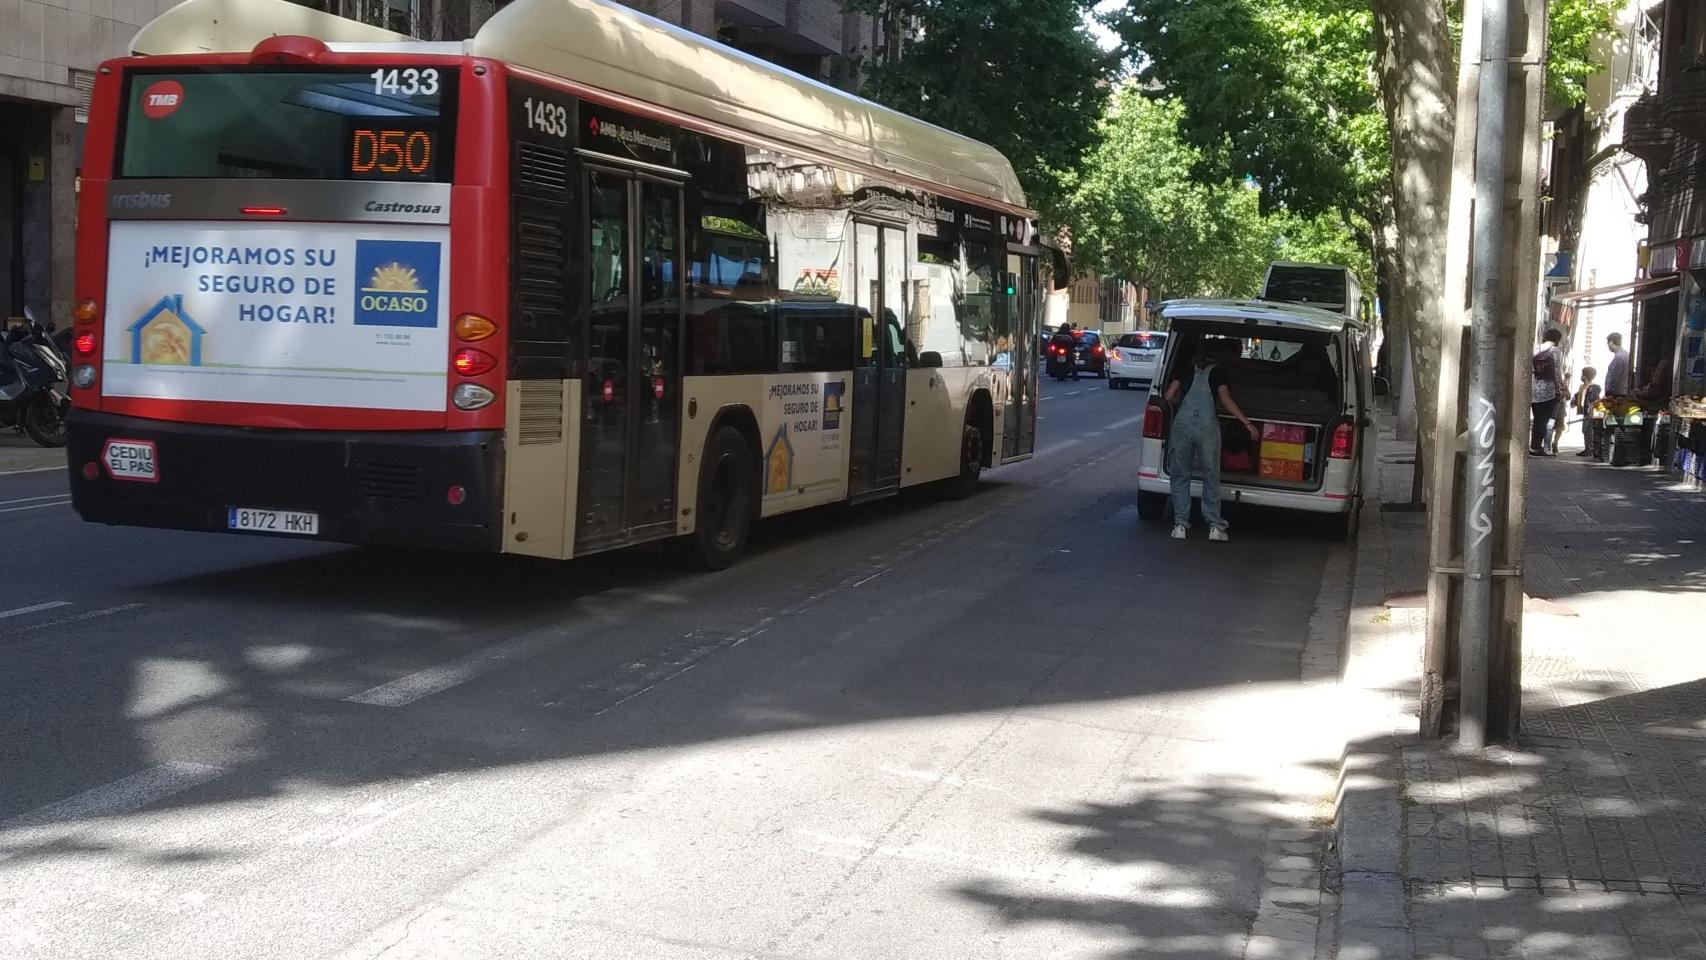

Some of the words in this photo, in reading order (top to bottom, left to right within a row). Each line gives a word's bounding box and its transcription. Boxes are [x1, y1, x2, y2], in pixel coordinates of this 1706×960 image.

[371, 68, 439, 95] 1433
[148, 94, 179, 107] TMB
[524, 97, 568, 138] 1433
[352, 130, 431, 173] D50
[364, 201, 442, 214] Castrosua
[145, 246, 295, 268] ¡MEJORAMOS
[304, 248, 336, 267] SU
[199, 275, 295, 294] SEGURO
[304, 277, 336, 296] DE
[361, 295, 428, 313] OCASO
[239, 304, 335, 324] HOGAR!
[769, 383, 810, 400] ¡MEJORAMOS
[810, 383, 819, 394] SU
[784, 402, 810, 415] SEGURO
[810, 401, 819, 413] DE
[793, 419, 818, 433] HOGAR!
[110, 445, 153, 460] CEDIU
[111, 459, 127, 471] EL
[129, 461, 153, 473] PAS
[240, 510, 277, 529] 8172
[285, 514, 313, 532] HKH
